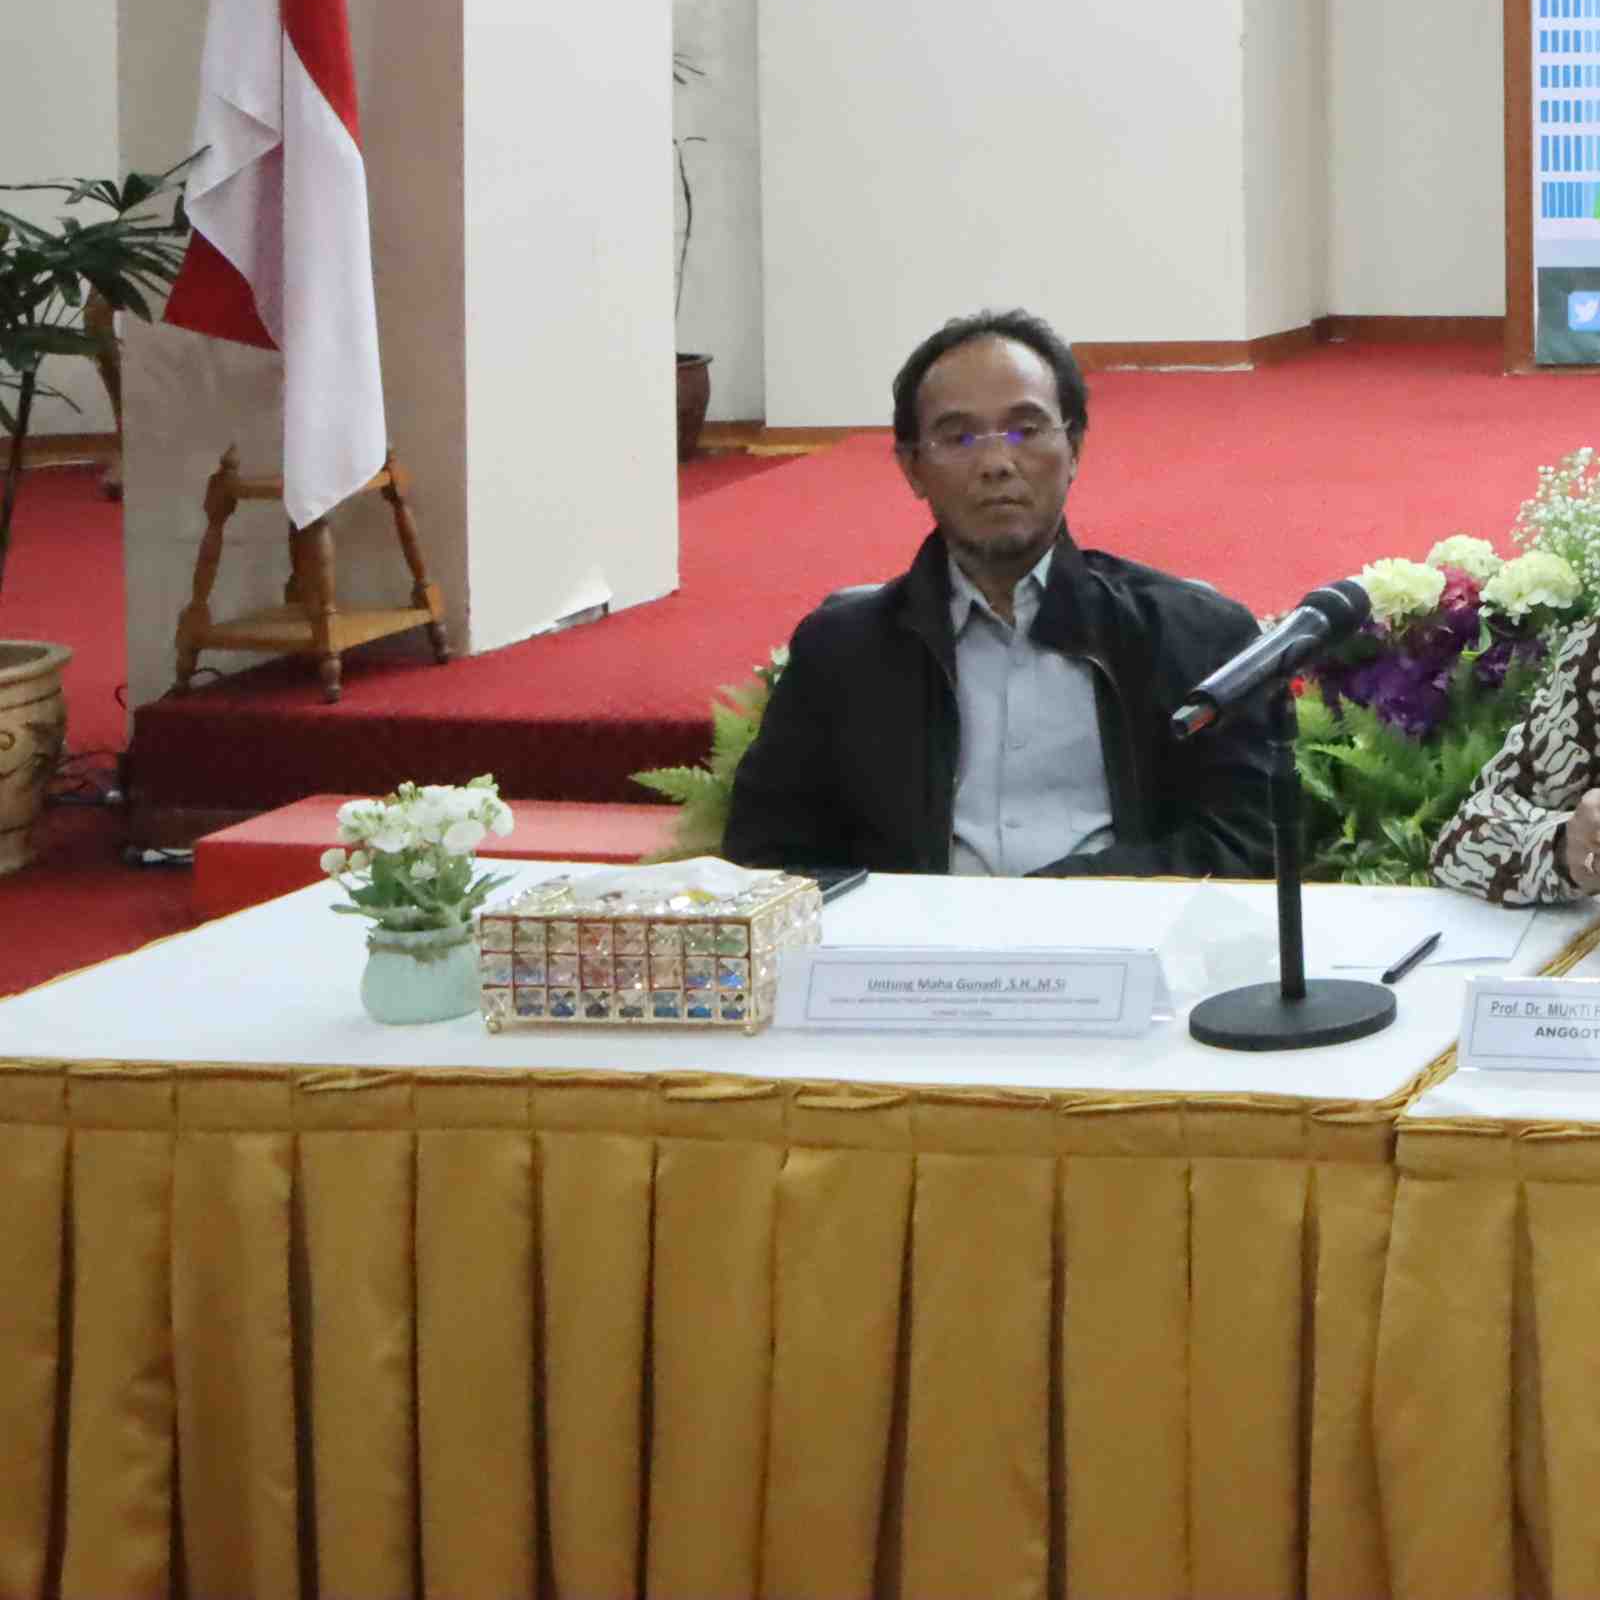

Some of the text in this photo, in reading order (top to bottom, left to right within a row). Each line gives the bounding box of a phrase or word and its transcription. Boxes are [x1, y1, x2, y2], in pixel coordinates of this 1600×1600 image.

[1491, 1003, 1519, 1016] Prof.
[1524, 1004, 1543, 1017] Dr.
[1548, 1004, 1592, 1017] MUKTI
